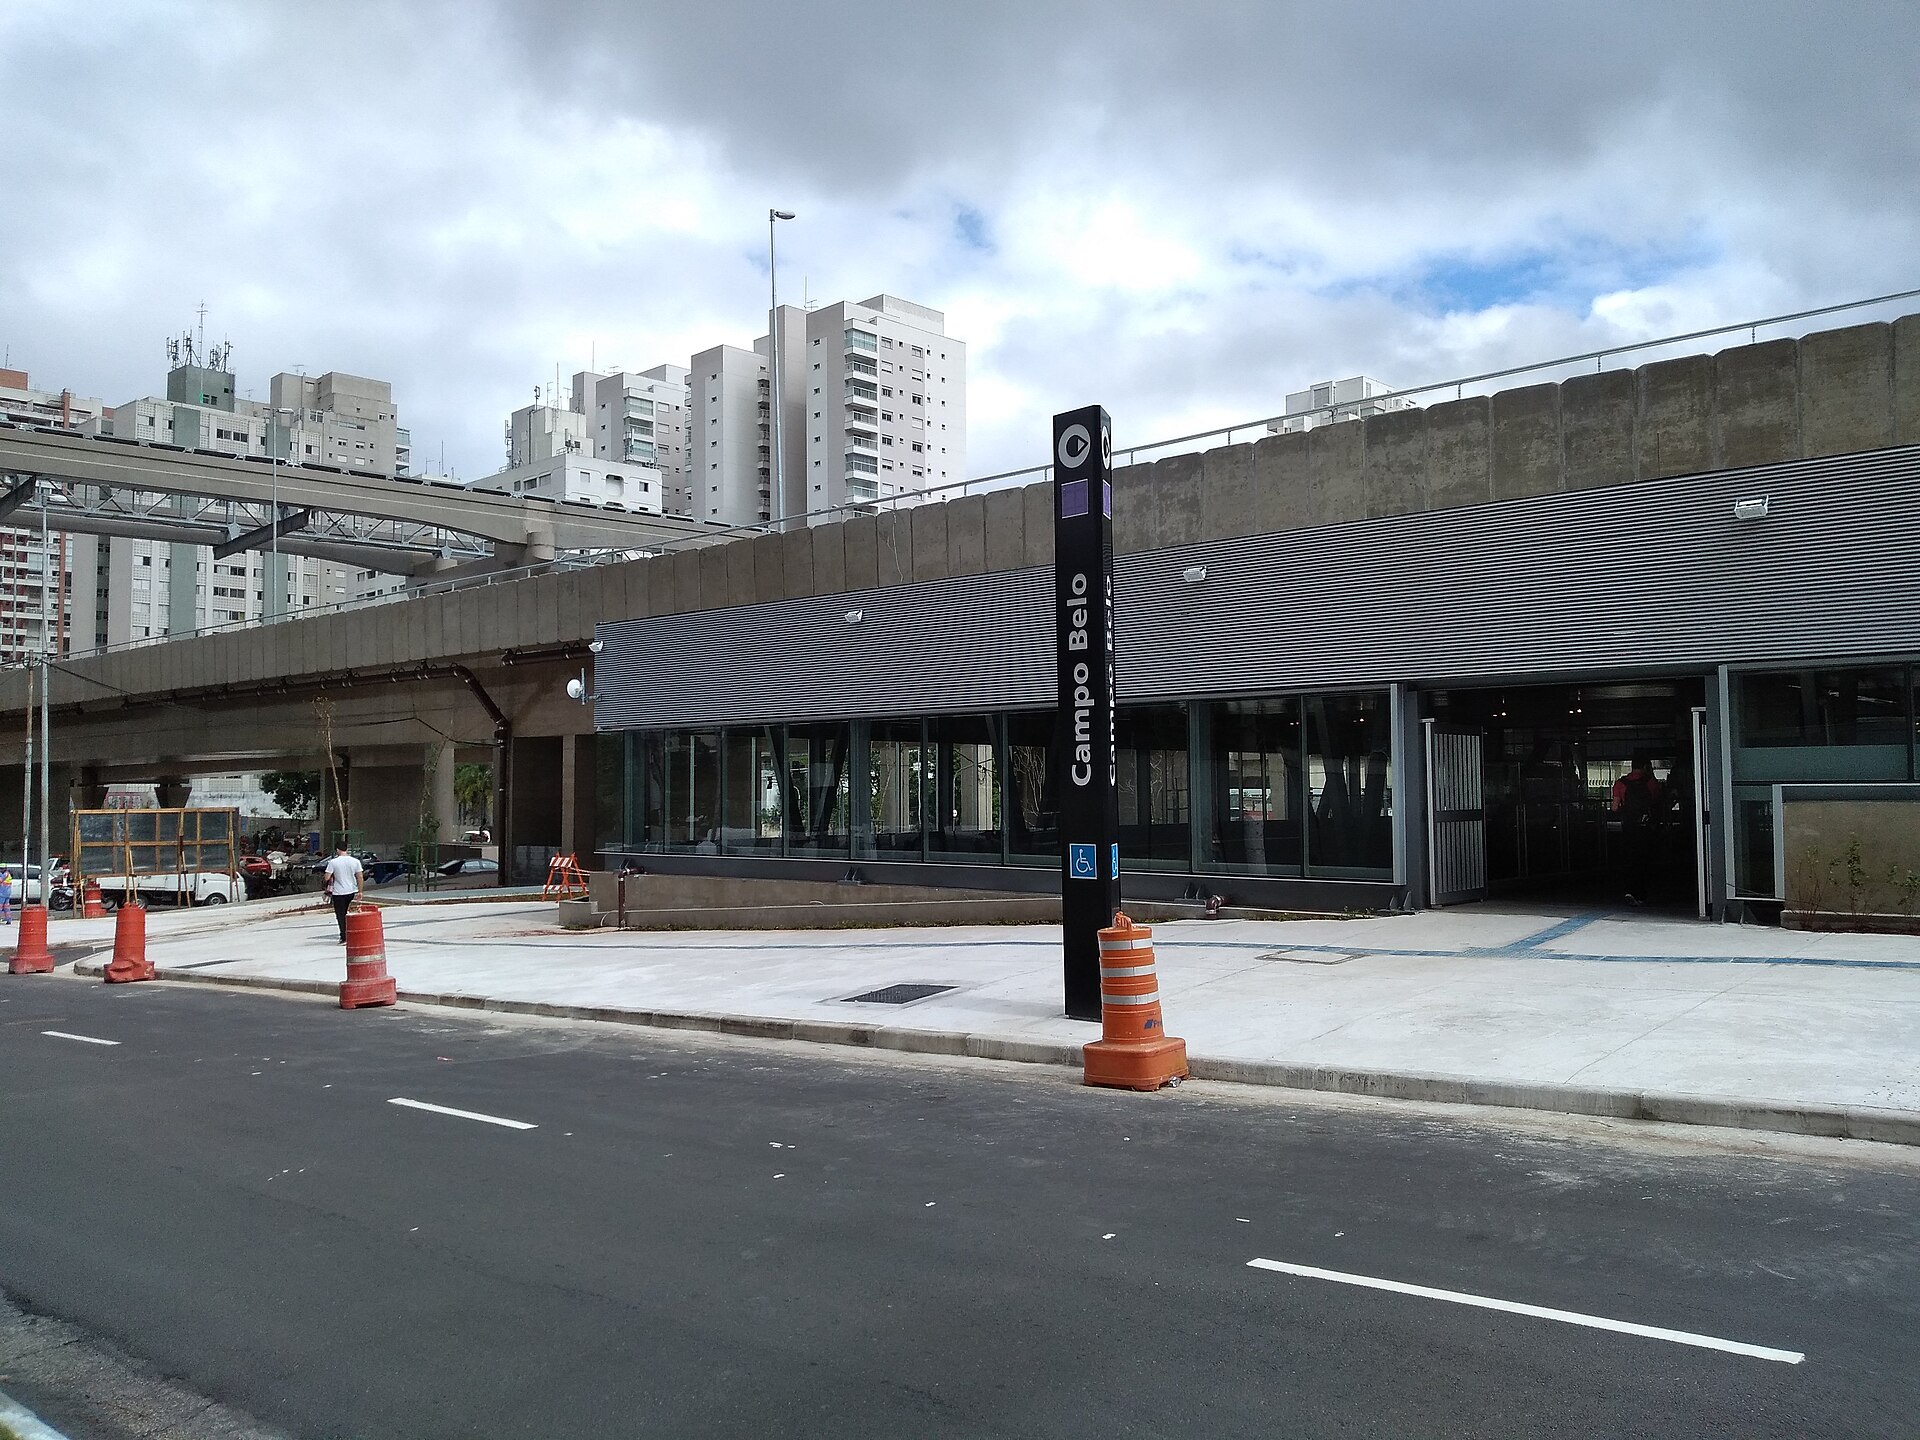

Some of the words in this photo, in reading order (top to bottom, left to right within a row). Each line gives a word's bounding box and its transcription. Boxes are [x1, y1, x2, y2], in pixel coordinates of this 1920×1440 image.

[1067, 573, 1088, 651] Belo
[1105, 575, 1113, 651] Belo
[1072, 662, 1095, 786] Campo
[1108, 663, 1116, 786] Campo
